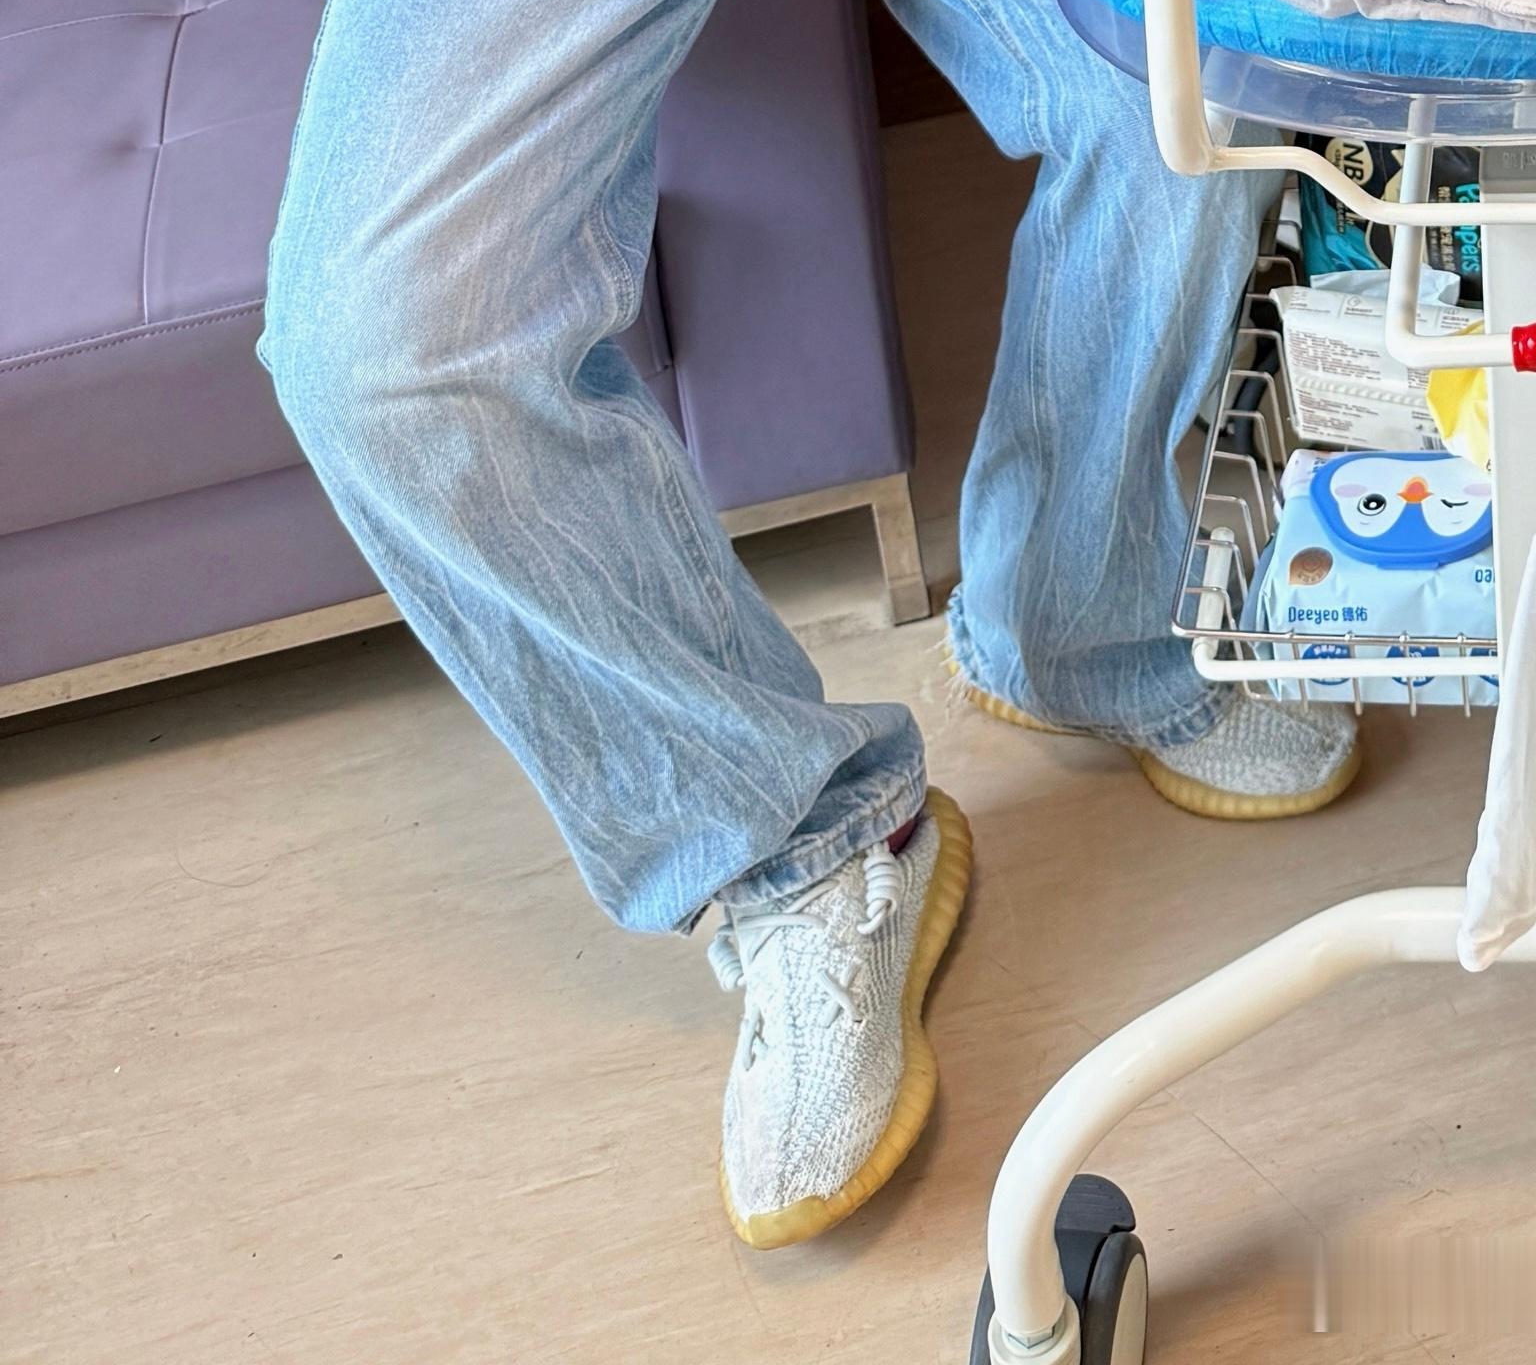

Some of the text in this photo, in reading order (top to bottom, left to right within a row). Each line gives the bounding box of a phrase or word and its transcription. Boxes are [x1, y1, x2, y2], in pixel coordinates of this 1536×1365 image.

[1343, 142, 1365, 182] NB
[1455, 183, 1481, 274] Papers
[1287, 605, 1369, 625] Deeyeo 德佑
